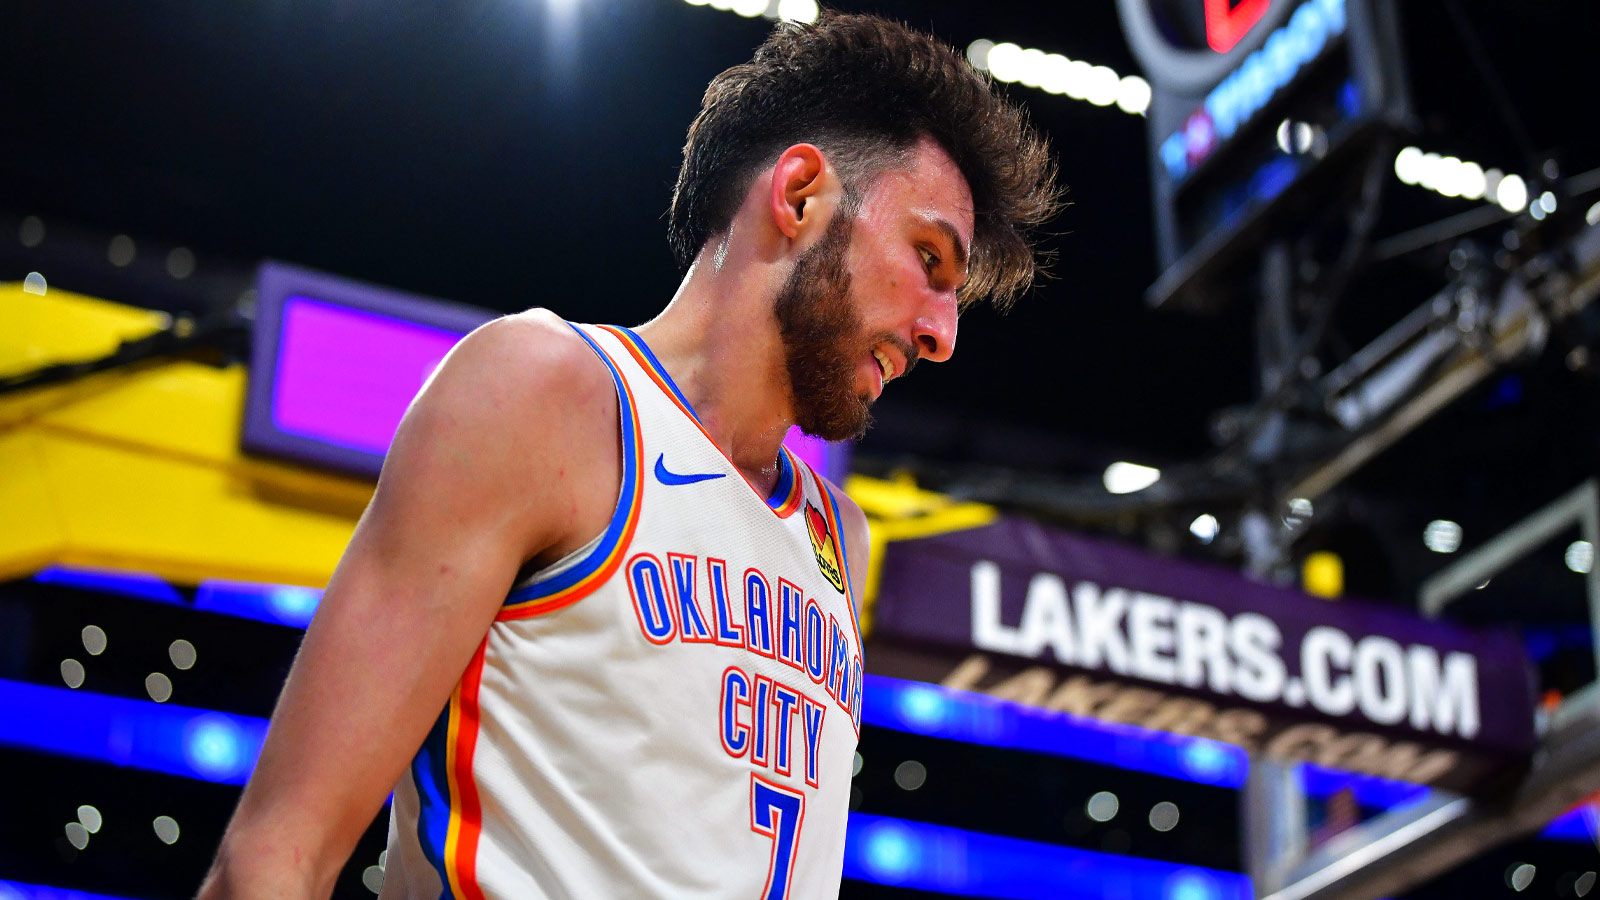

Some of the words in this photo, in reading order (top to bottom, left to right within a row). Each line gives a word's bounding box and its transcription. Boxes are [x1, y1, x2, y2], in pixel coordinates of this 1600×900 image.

[626, 552, 863, 741] OKLAHOMA
[969, 560, 1481, 739] LAKERS.COM
[719, 665, 826, 789] CITY
[750, 771, 805, 900] 7
